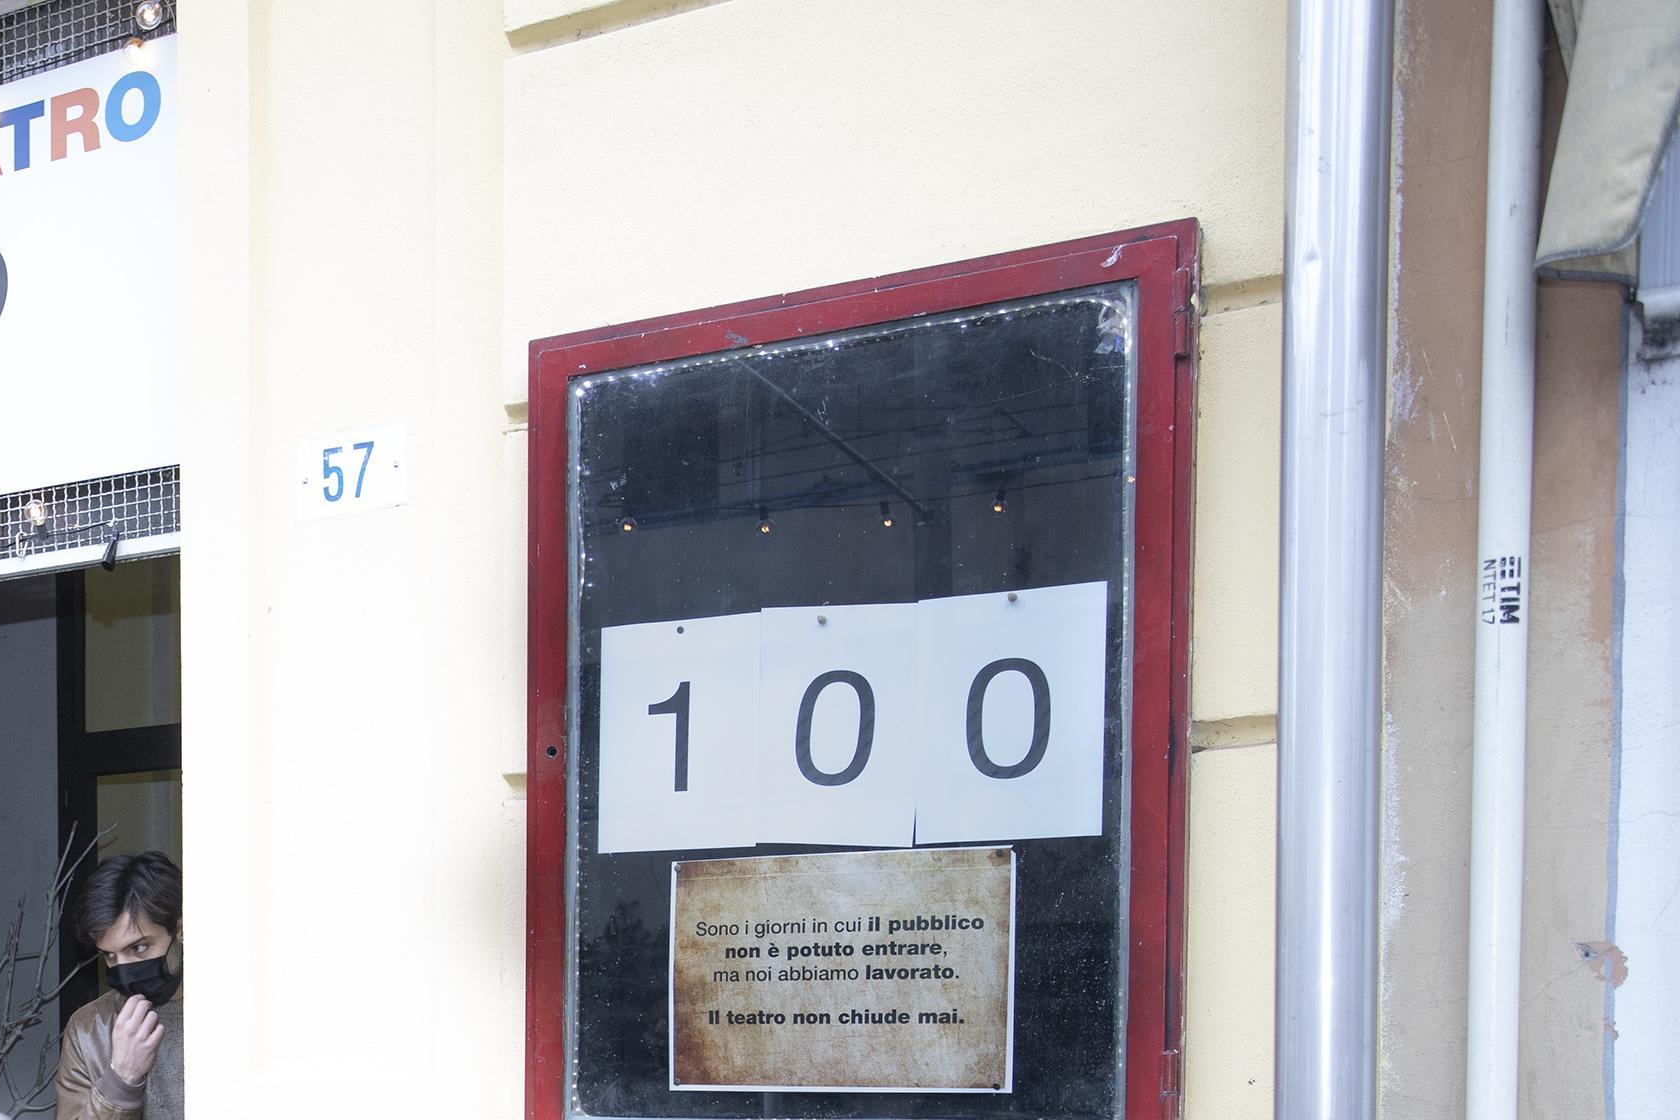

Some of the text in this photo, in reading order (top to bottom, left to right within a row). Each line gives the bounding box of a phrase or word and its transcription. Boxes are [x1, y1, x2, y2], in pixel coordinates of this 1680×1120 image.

[323, 441, 374, 502] 57
[1500, 582, 1521, 624] TIM
[1482, 608, 1495, 625] 17
[696, 915, 985, 939] Sono i giorni in cui il pubblico
[725, 941, 948, 960] non è potuto entrare,
[713, 964, 960, 982] ma noi abbiamo lavorato.
[708, 1009, 965, 1025] Il teatro non chiude mai.
